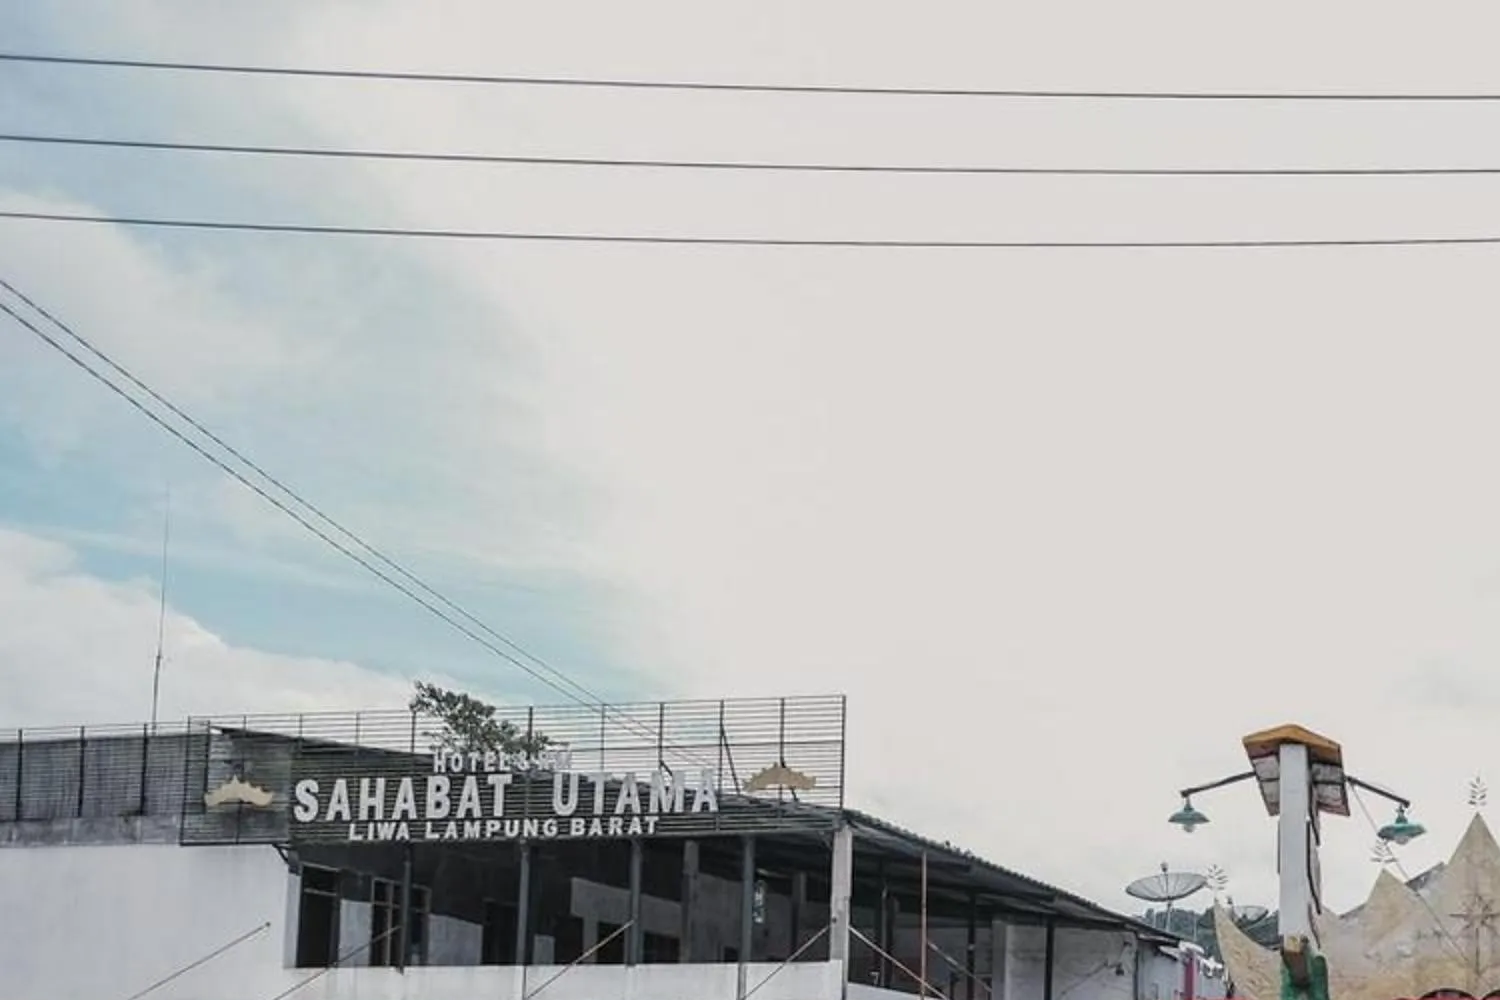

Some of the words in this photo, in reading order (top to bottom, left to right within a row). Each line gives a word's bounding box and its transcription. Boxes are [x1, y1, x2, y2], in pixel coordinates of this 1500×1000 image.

[433, 750, 511, 773] HOTEL
[294, 773, 513, 822] SAHABAT
[552, 769, 720, 816] UTAMA
[348, 822, 410, 841] LIWA
[425, 818, 558, 839] LAMPUNG
[569, 815, 660, 836] BARAT
